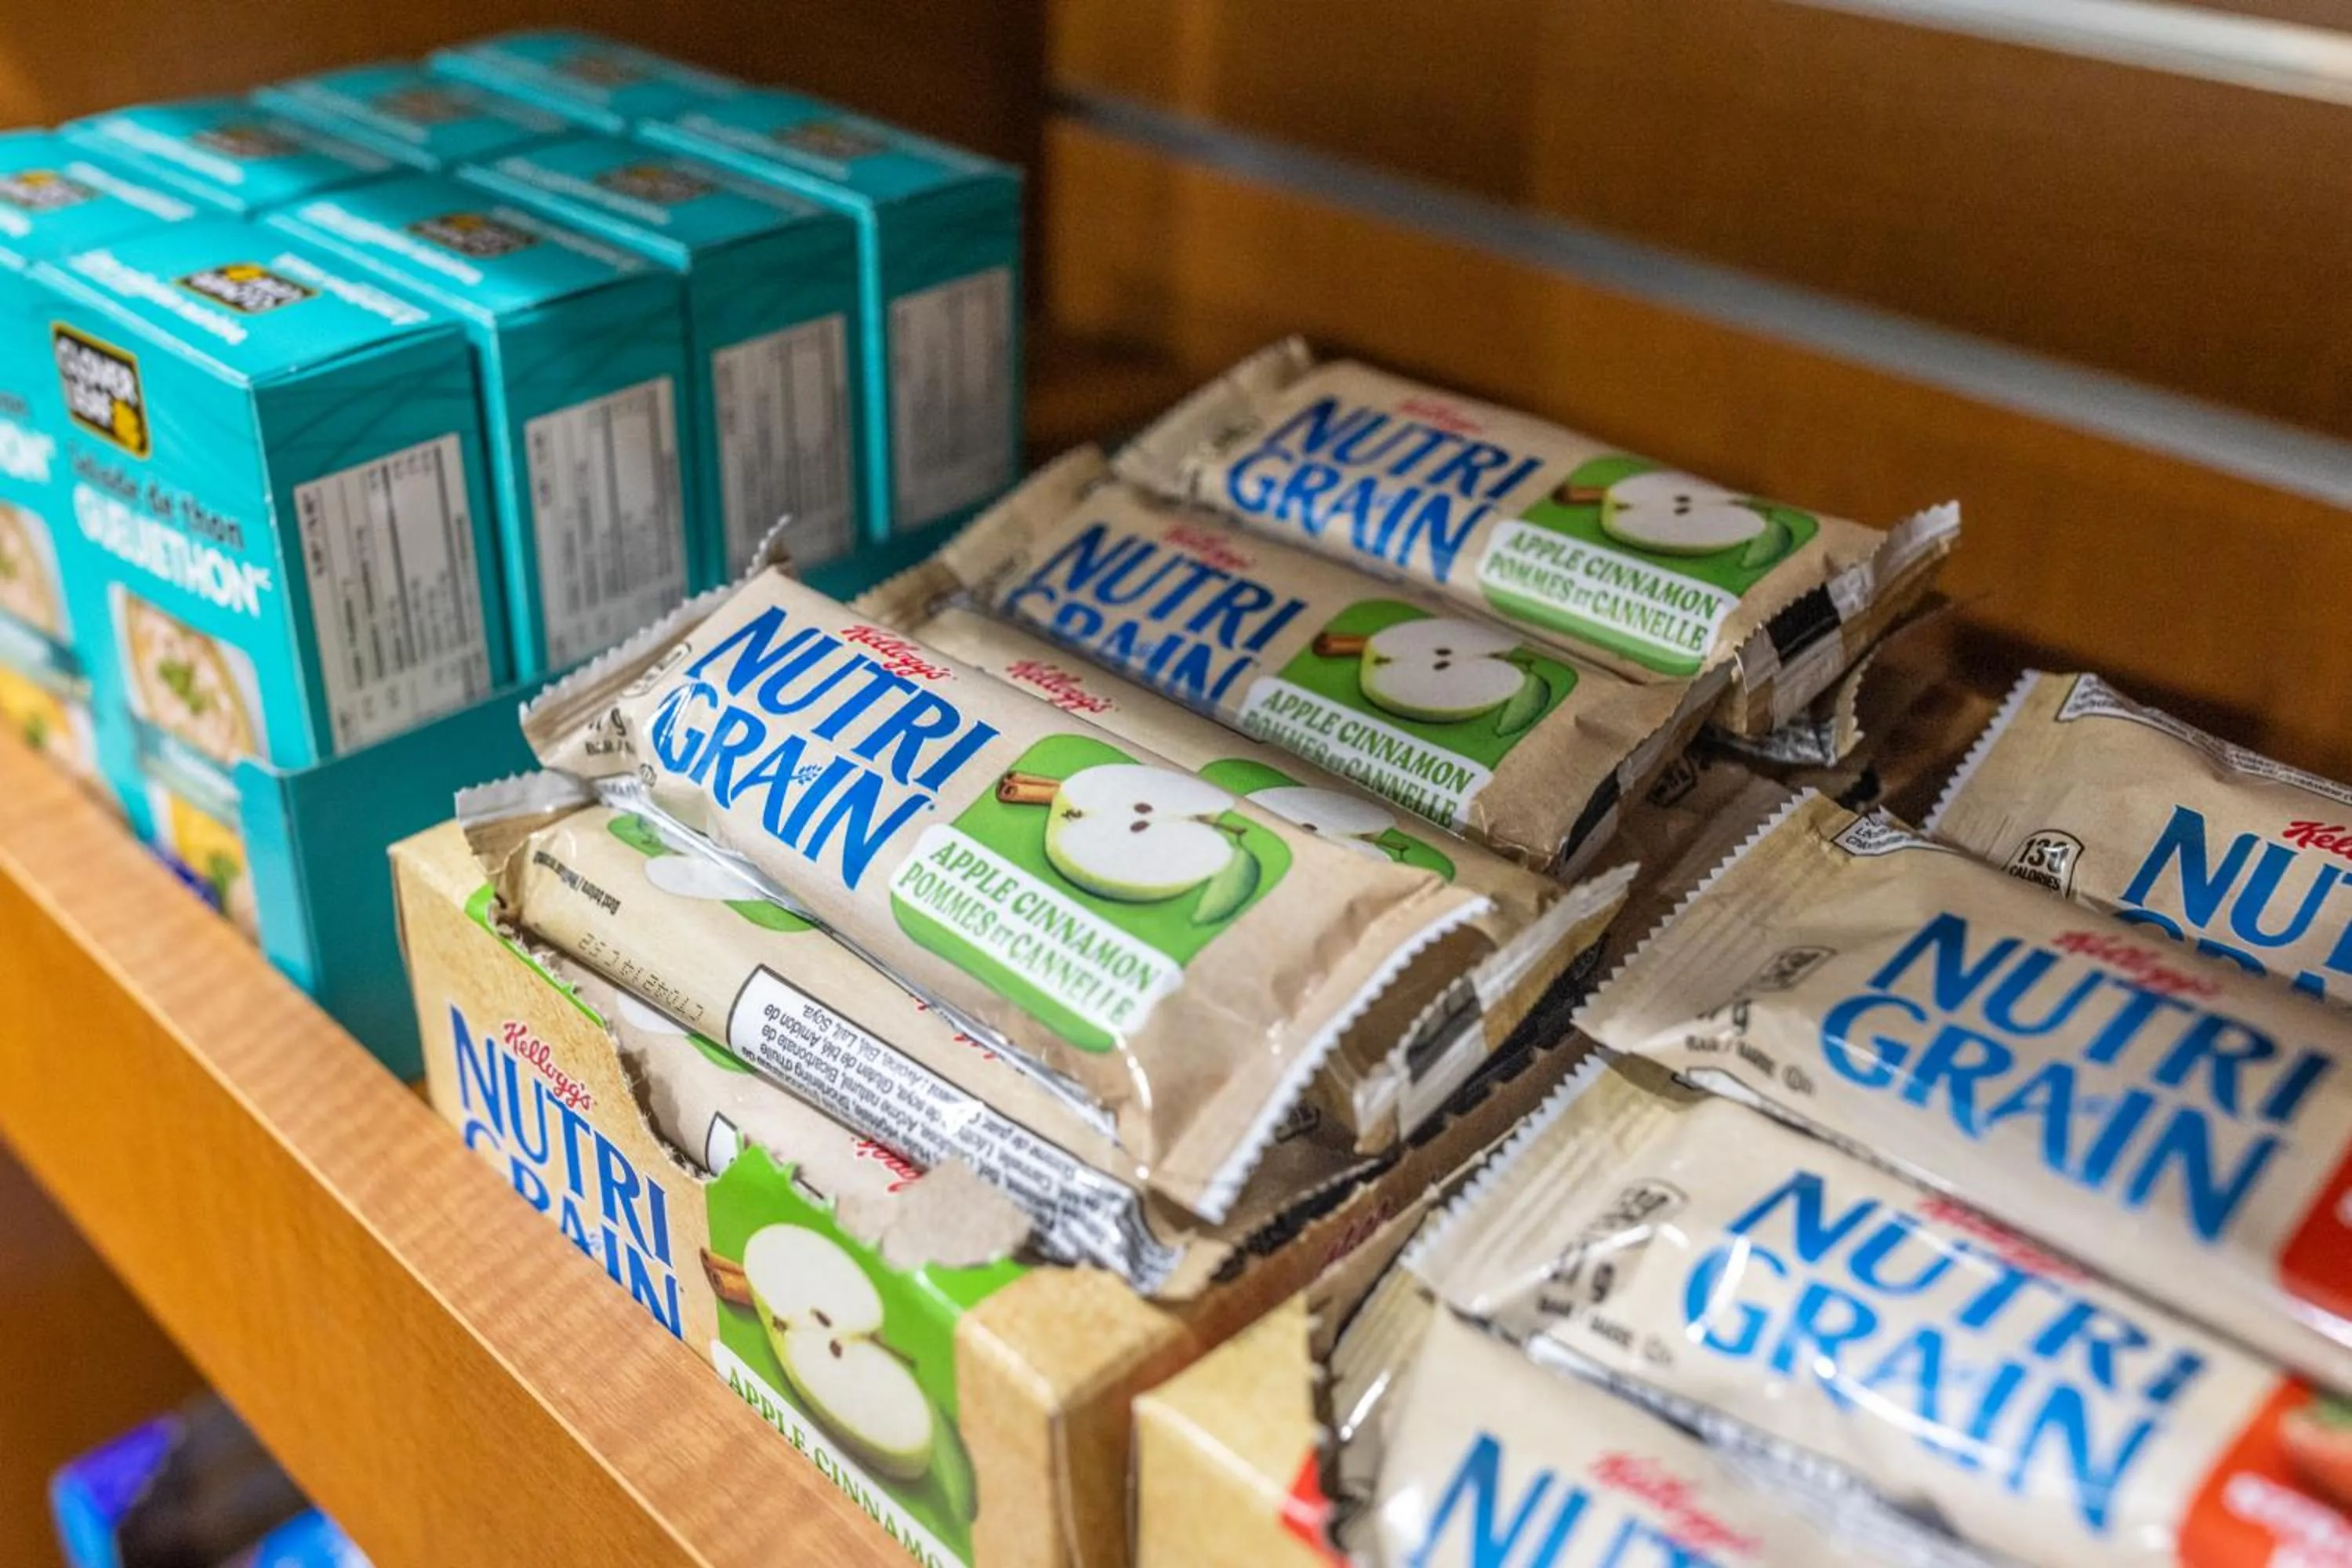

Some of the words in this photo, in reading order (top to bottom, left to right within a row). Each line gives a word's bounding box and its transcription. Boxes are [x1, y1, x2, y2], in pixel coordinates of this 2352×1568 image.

[1261, 395, 1544, 499] NUTRI
[1226, 444, 1494, 584] GRAIN
[1022, 522, 1308, 652] NUTRI
[1487, 552, 1577, 603] POMMES
[1591, 591, 1710, 652] CANNELLE
[1506, 531, 1587, 575] APPLE
[1584, 557, 1723, 620] CINNAMON
[685, 606, 1000, 793] NUTRI
[841, 625, 952, 680] Kellogg's
[652, 682, 931, 891] GRAIN
[1261, 688, 1341, 735] APPLE
[1337, 720, 1476, 795] CINNAMON
[1342, 757, 1458, 828] CANNELLE
[898, 862, 999, 937] POMMES
[1008, 933, 1134, 1024] CANNELLE
[929, 841, 1019, 903] APPLE
[1012, 889, 1160, 994] CINNAMON
[760, 1025, 777, 1041] de
[762, 1003, 781, 1021] de
[775, 1036, 838, 1080] Bicarbonate
[779, 1014, 820, 1045] Amidon
[800, 1003, 833, 1031] Soya.
[839, 1052, 856, 1069] de
[1867, 912, 2332, 1123] NUTRI
[503, 1022, 592, 1110] Kellogg's
[855, 1062, 894, 1092] Gluten
[450, 1004, 673, 1268] NUTRI
[1820, 994, 2281, 1243] GRAIN
[1725, 1171, 2206, 1403] NUTRI
[1682, 1245, 2156, 1530] GRAIN
